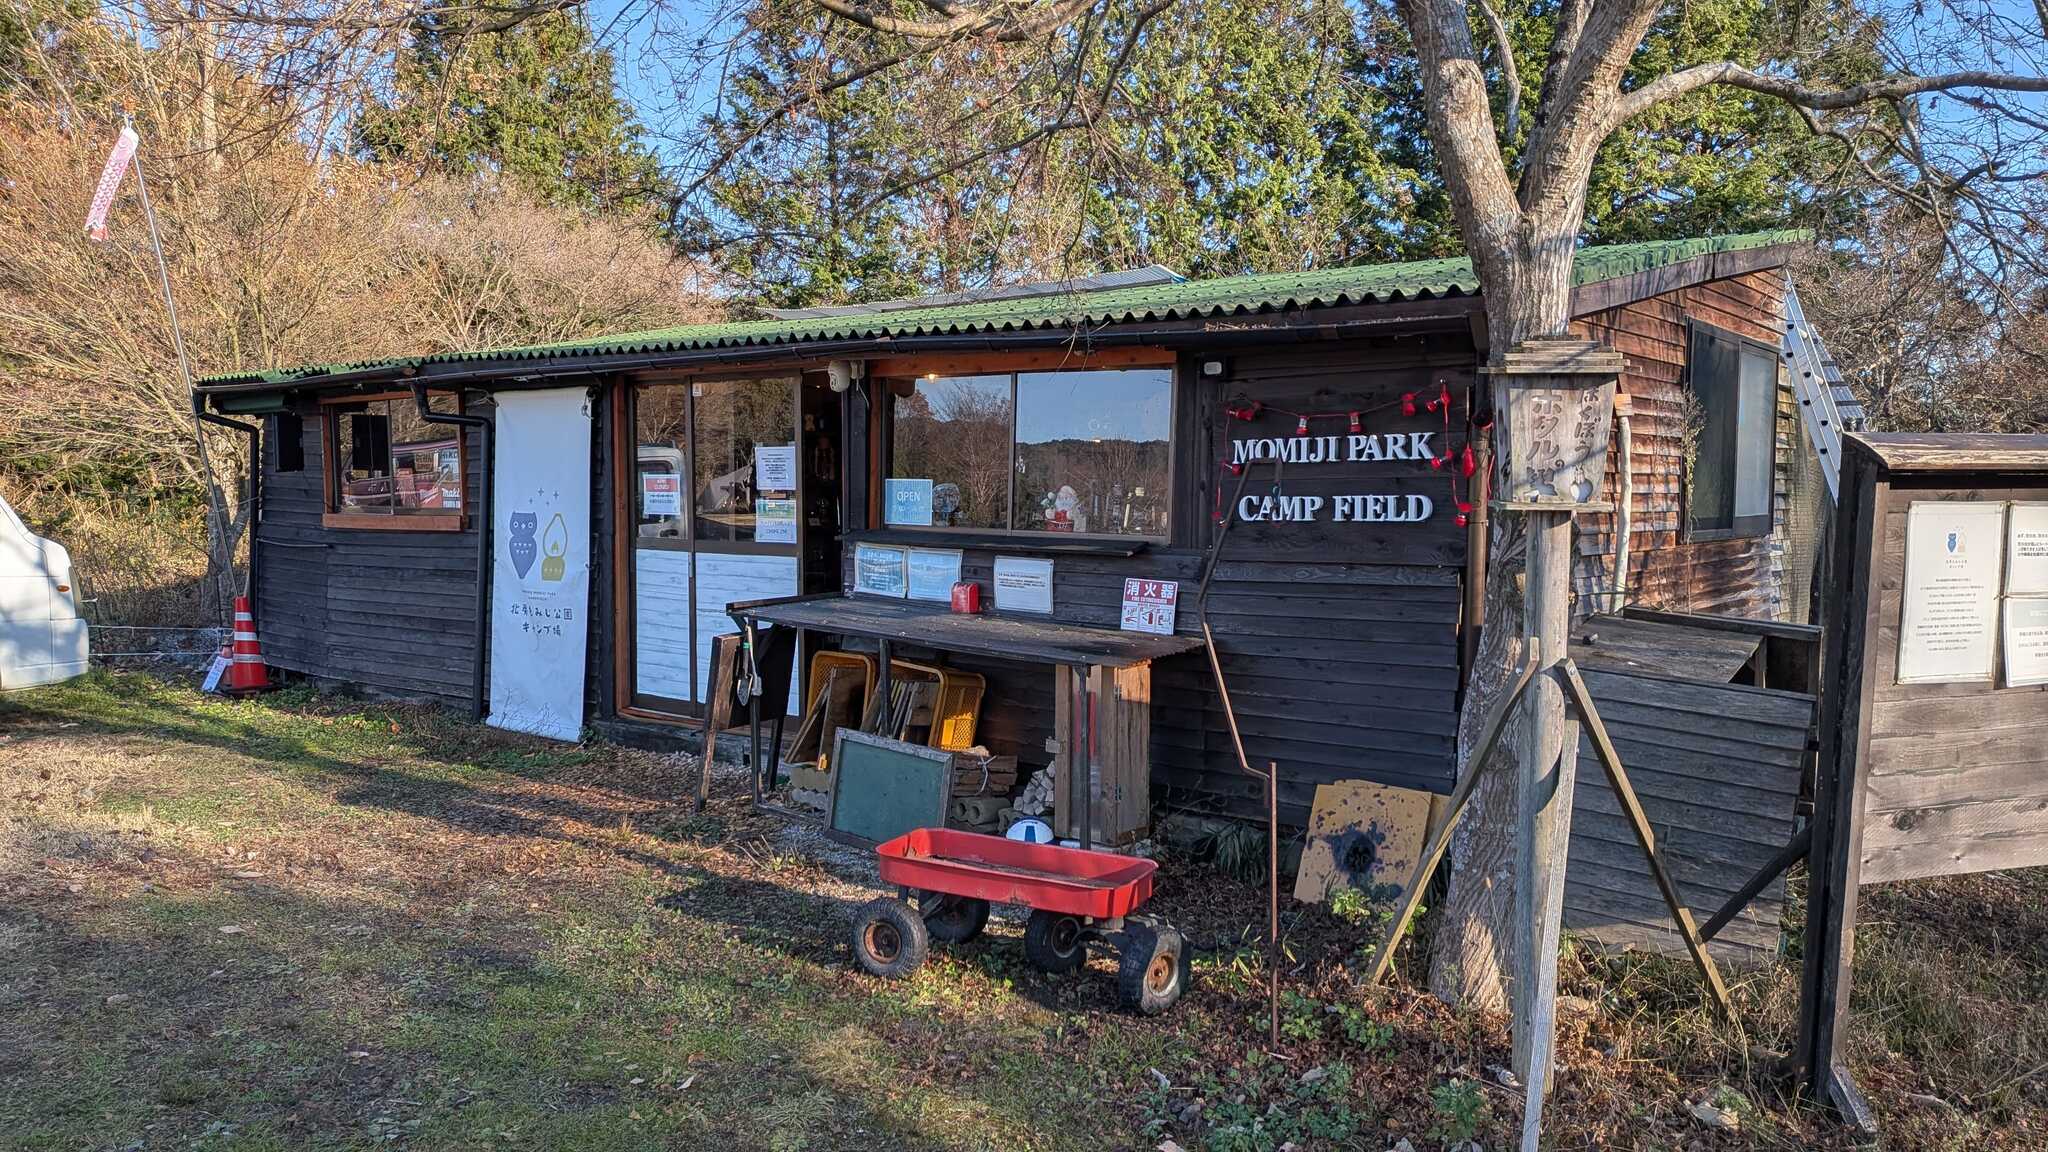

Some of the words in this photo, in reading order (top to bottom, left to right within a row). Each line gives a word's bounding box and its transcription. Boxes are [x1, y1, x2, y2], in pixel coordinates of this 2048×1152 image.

[1232, 435, 1341, 465] MOMIJI
[1347, 431, 1437, 461] PARK
[896, 491, 921, 502] OPEN
[1238, 495, 1324, 522] CAMP
[1332, 494, 1434, 522] FIELD
[1127, 581, 1175, 598] 消火器
